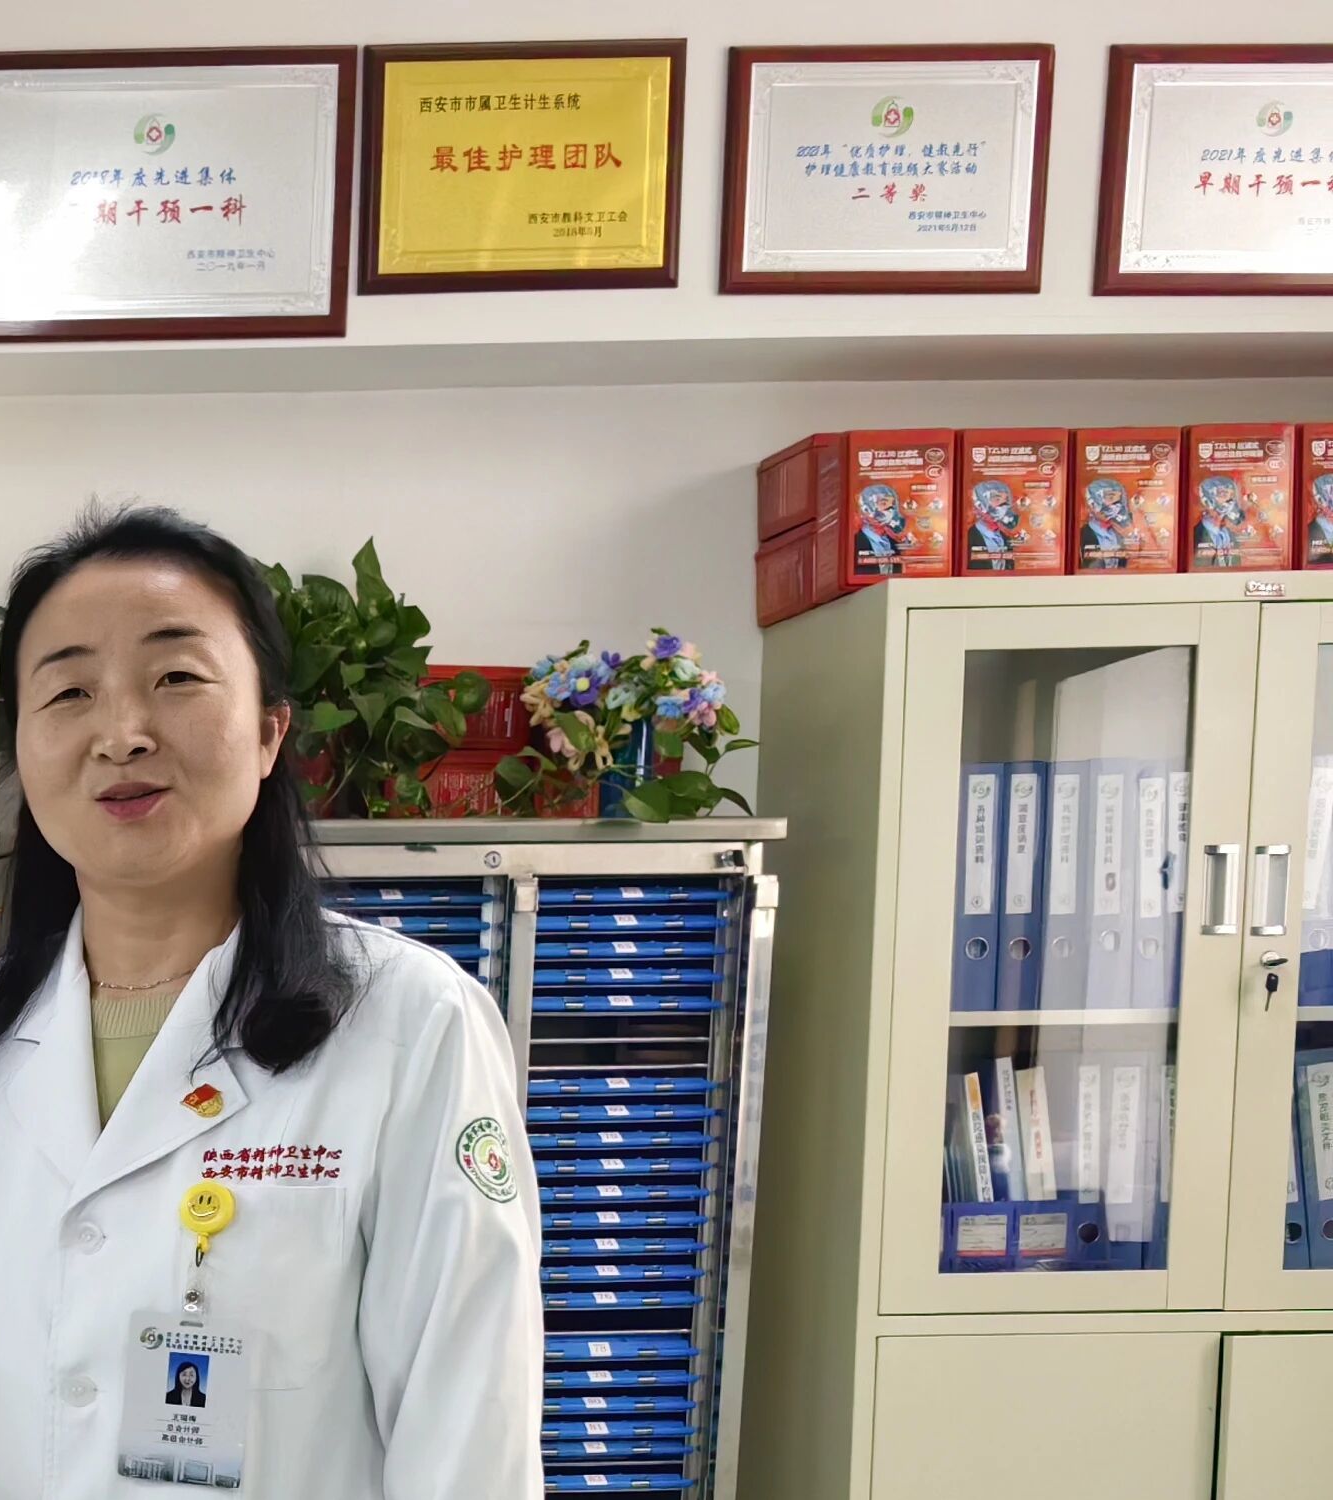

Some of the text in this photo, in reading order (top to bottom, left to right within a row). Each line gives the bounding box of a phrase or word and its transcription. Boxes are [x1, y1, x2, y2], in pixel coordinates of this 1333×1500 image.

[419, 93, 582, 114] 西安市市属卫生计生系统
[430, 142, 622, 173] 最佳护理团队
[1201, 147, 1333, 164] 2021年度先进集
[851, 183, 928, 204] 二等奖
[69, 193, 247, 226] 期干预一科
[202, 1144, 343, 1164] 陕西省精神卫生中心
[201, 1163, 341, 1181] 西安市精神卫生中心
